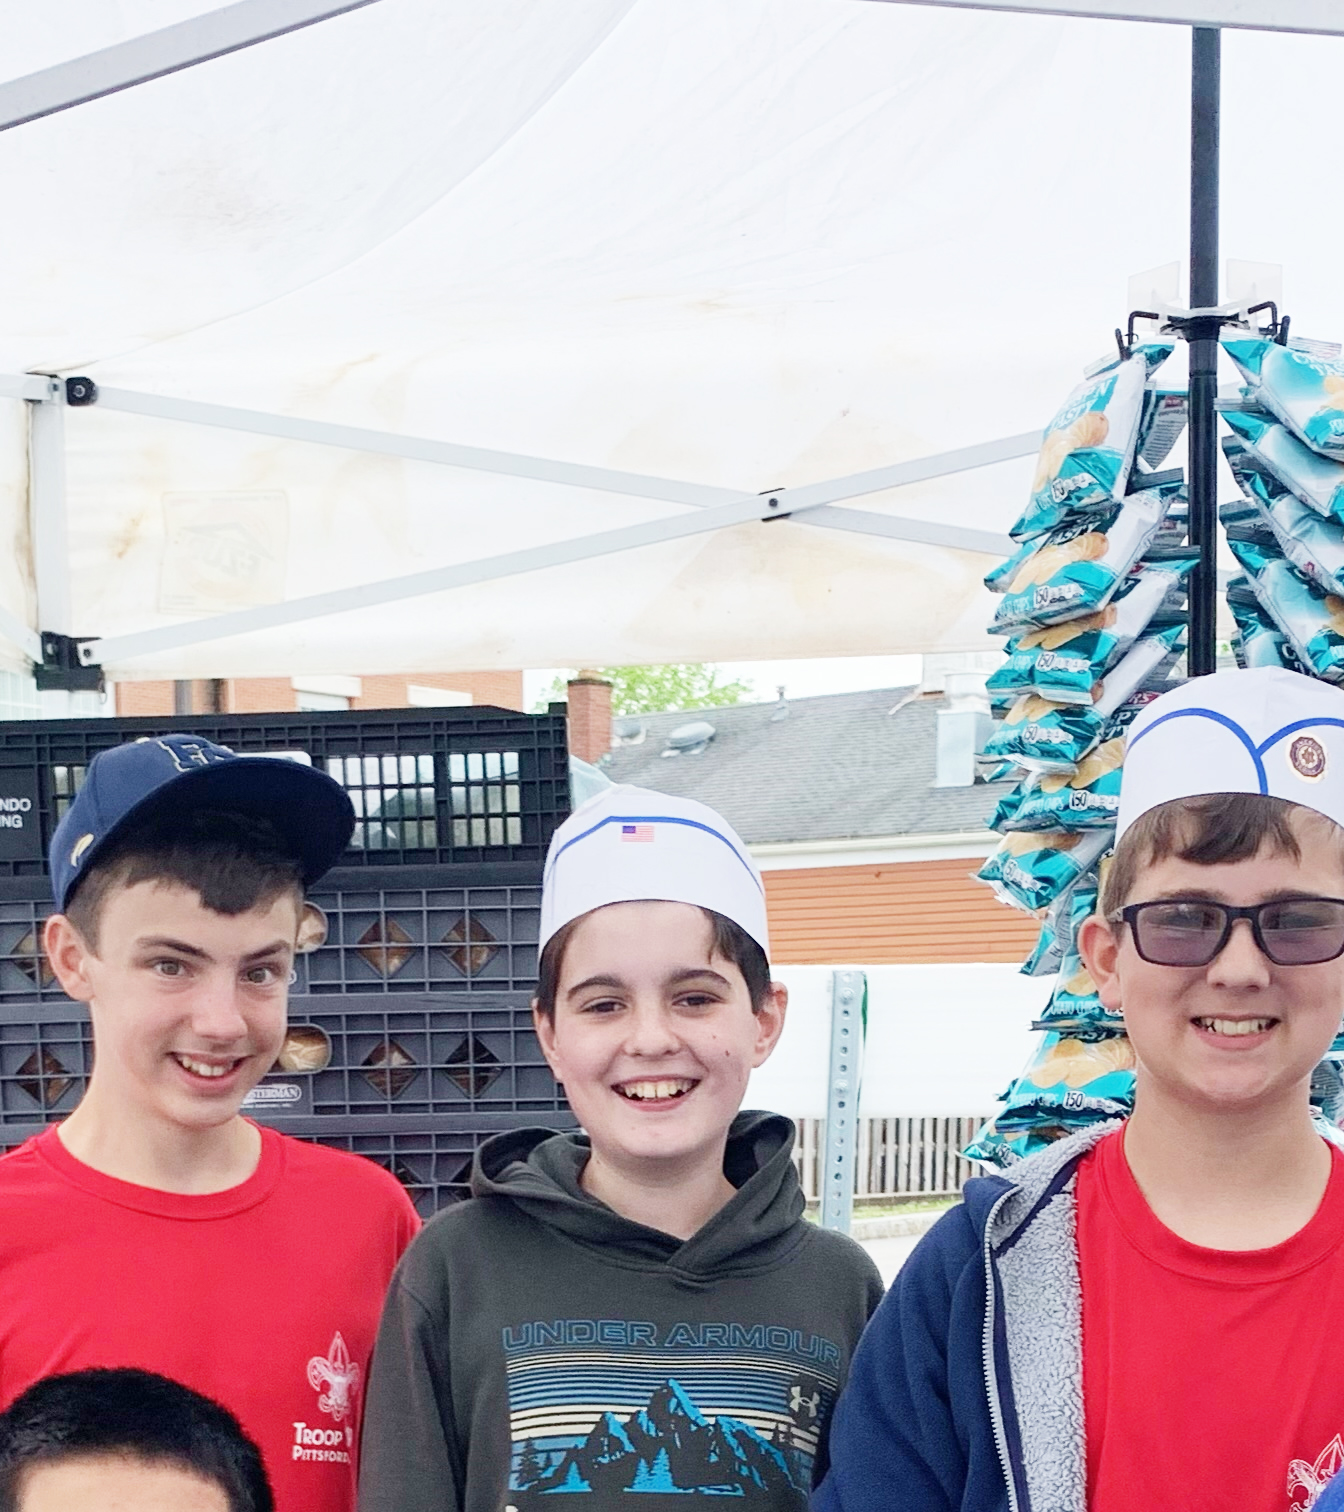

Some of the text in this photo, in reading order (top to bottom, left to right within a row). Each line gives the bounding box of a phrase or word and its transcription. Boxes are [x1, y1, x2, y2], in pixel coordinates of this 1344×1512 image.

[1065, 1091, 1083, 1108] 150
[503, 1320, 841, 1368] UNDER ARMOUR
[293, 1422, 343, 1446] TROOP
